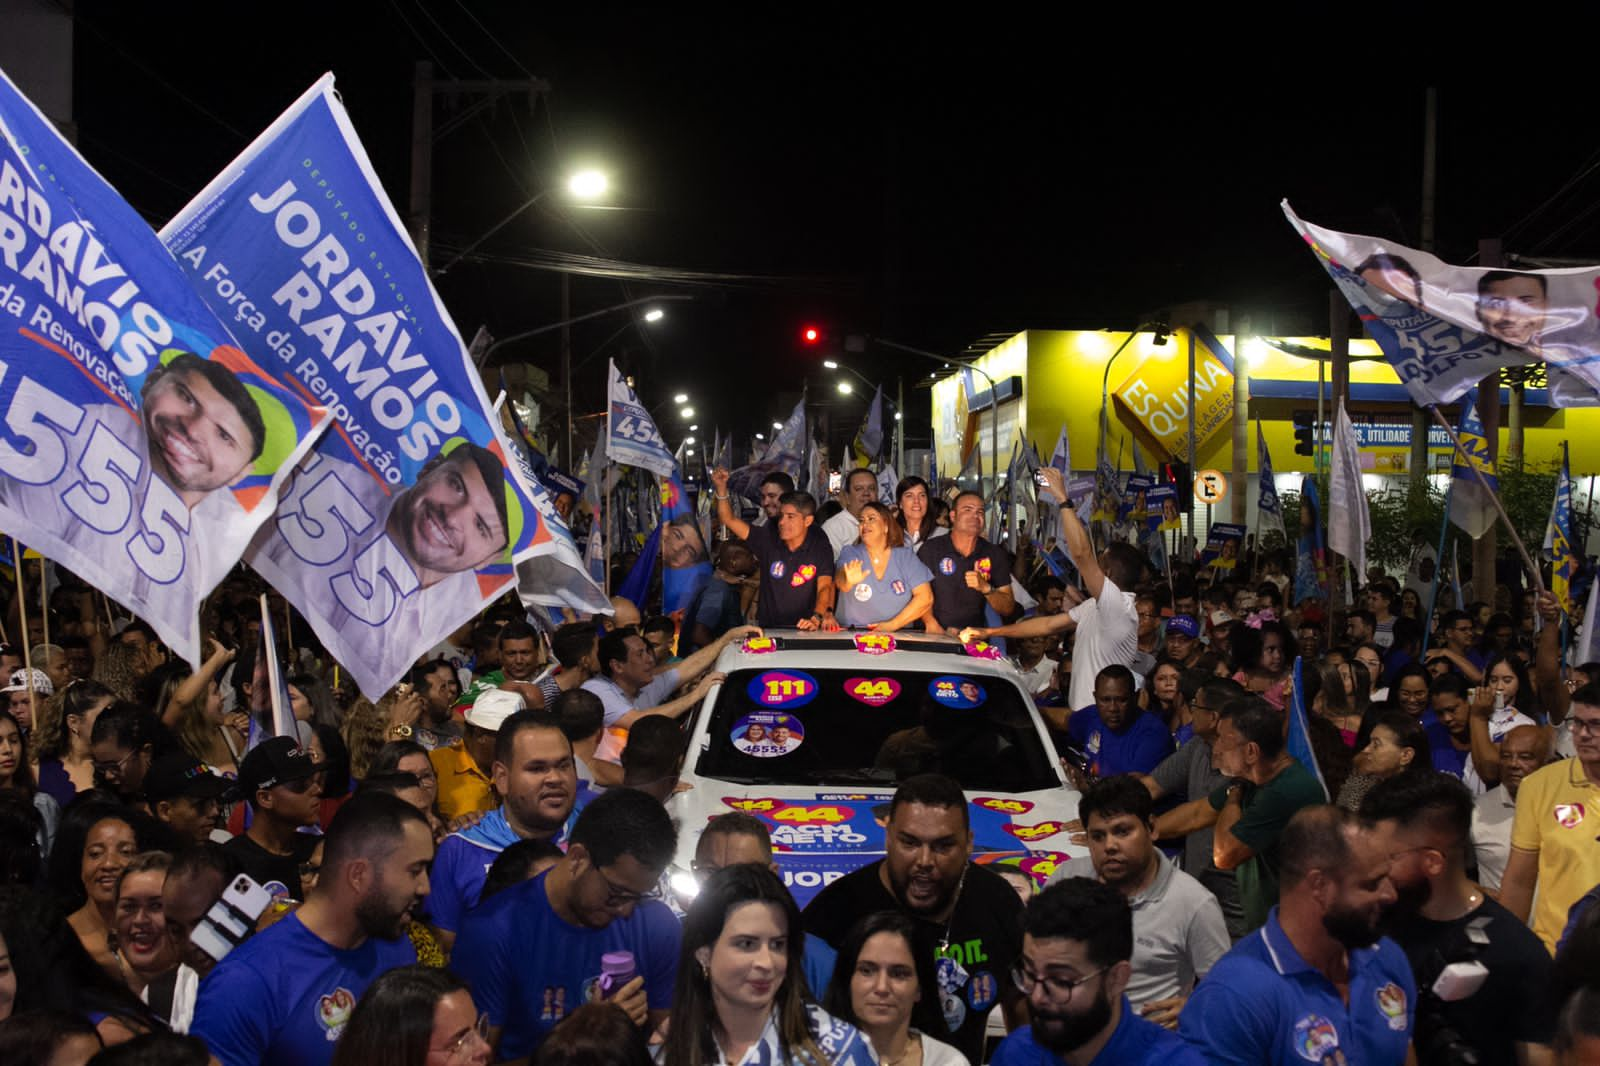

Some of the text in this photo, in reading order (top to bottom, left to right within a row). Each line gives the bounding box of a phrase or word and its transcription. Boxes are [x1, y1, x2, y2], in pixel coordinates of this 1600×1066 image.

[302, 157, 367, 244] DEPUTADO
[0, 209, 158, 377] RAMOS
[249, 180, 463, 434] JORDÁVIO
[183, 245, 208, 270] A
[203, 262, 268, 333] Força
[266, 329, 298, 364] da
[295, 357, 402, 486] Renovação
[271, 269, 441, 462] RAMOS
[1122, 378, 1159, 417] ES
[1149, 359, 1228, 436] QUINA
[1367, 430, 1410, 443] UTILIDADE
[0, 361, 192, 585] 555
[1204, 476, 1217, 497] E
[765, 680, 805, 695] 111
[854, 681, 893, 696] 44
[773, 807, 845, 822] 44
[984, 800, 1027, 812] 44
[770, 832, 867, 843] NETO
[773, 824, 852, 834] ACM
[1013, 823, 1057, 838] 44
[784, 871, 851, 887] JOR
